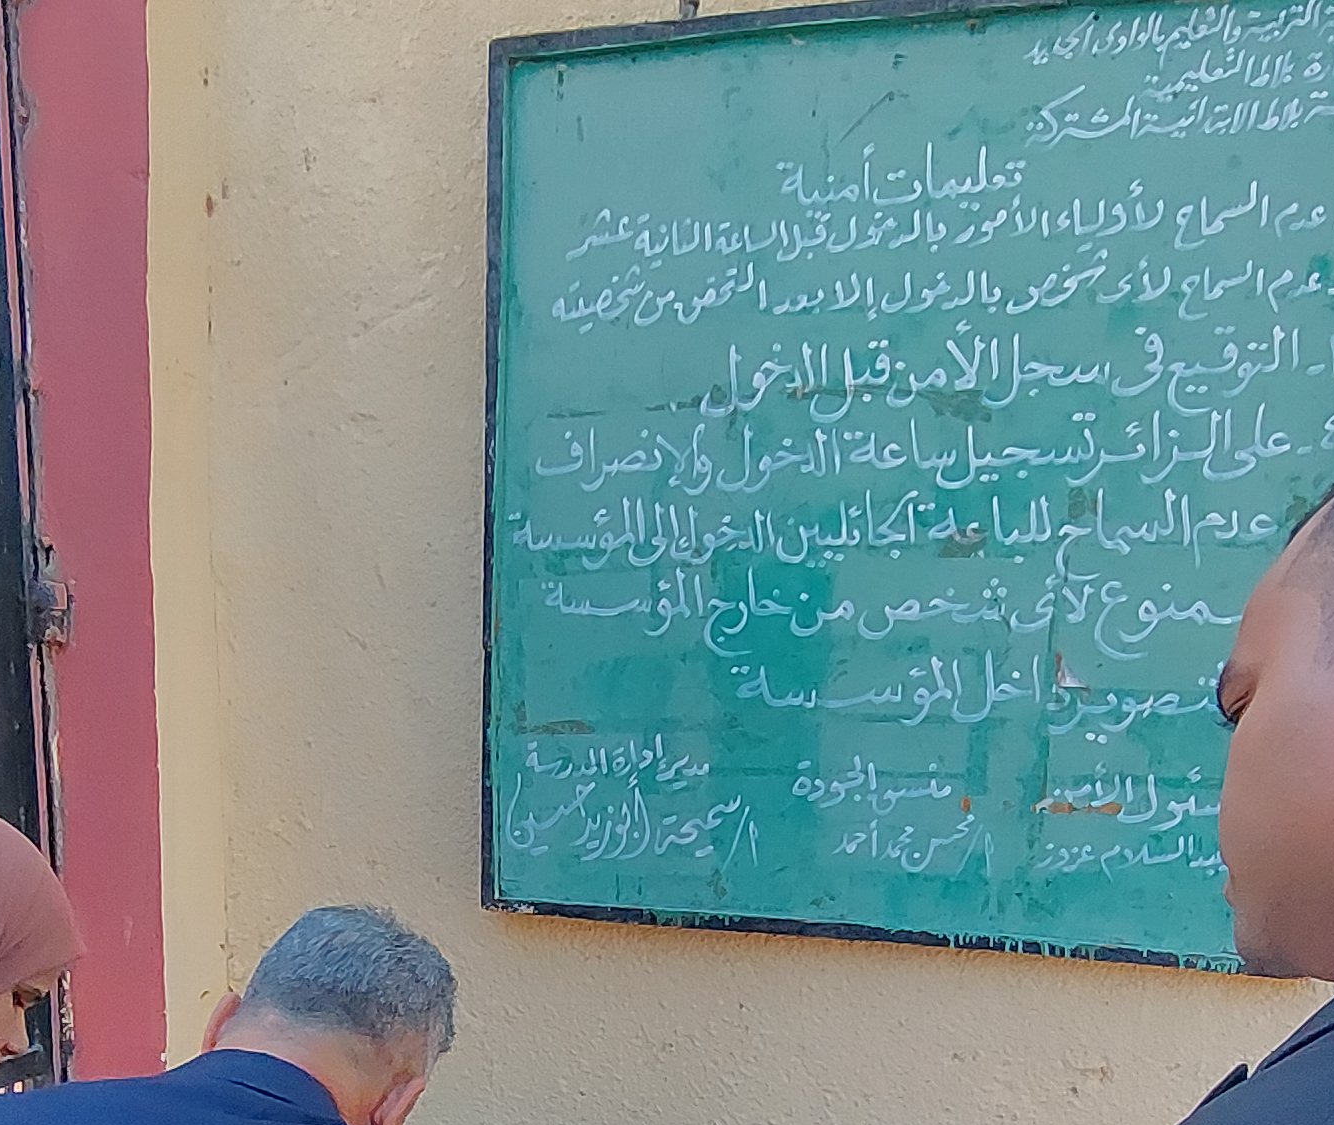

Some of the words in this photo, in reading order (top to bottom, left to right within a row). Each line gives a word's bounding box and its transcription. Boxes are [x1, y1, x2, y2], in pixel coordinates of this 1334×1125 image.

[1023, 11, 1095, 65] الجديد
[1156, 4, 1242, 70] والتعليم
[1241, 0, 1323, 43] التربية
[1140, 48, 1255, 102] التعليمية
[1249, 50, 1295, 88] بلاط
[1024, 85, 1141, 149] المشتركة
[1257, 97, 1303, 131] بلاط
[776, 143, 875, 218] أمنية
[872, 141, 1026, 211] تعليمات
[565, 208, 634, 261] عشر
[634, 213, 711, 269] الثانية
[716, 220, 786, 256] الساعة
[777, 212, 832, 261] قبل
[825, 208, 947, 253] بالدخول
[954, 194, 1050, 247] الأمور
[1056, 178, 1165, 252] لأولياء
[1174, 180, 1269, 250] السماح
[1274, 202, 1326, 239] عدم
[552, 264, 646, 335] شخصيته
[633, 290, 676, 326] من
[773, 288, 823, 316] بعد
[880, 270, 1002, 314] بالدخول
[1006, 248, 1108, 315] شخص
[1178, 260, 1264, 321] السماح
[1268, 269, 1322, 313] عدم
[700, 341, 828, 417] الدخول
[811, 339, 890, 423] قبل
[885, 320, 999, 407] الأمن
[983, 332, 1111, 408] سجل
[1166, 324, 1299, 416] التوقيع
[716, 422, 841, 493] الدخول
[848, 417, 957, 471] ساعة
[936, 411, 1096, 490] تسجيل
[1067, 409, 1232, 486] الزائر
[1202, 402, 1292, 482] على
[508, 497, 645, 570] المؤسسة
[628, 501, 689, 567] إلى
[670, 505, 775, 565] الدخول
[776, 489, 919, 568] الجائلين
[917, 494, 1052, 564] للباعة
[1056, 487, 1191, 580] السماح
[1193, 511, 1278, 568] عدم
[541, 566, 704, 636] المؤسسة
[702, 566, 792, 657] خارج
[789, 592, 855, 637] من
[857, 578, 1008, 641] شخص
[1094, 581, 1243, 660] منوع
[730, 656, 962, 726] المؤسسة
[1047, 661, 1224, 744] تصوير
[526, 741, 607, 780] المدرسة
[655, 755, 710, 790] مدير
[792, 755, 877, 808] الجودة
[867, 763, 952, 816] منسق
[505, 773, 595, 856] حسين
[1116, 766, 1221, 831] سئول
[831, 819, 878, 858] أحمد
[880, 826, 915, 860] محمد
[901, 814, 975, 872] محسن
[1100, 834, 1194, 883] السلام
[1189, 851, 1230, 876] بد
